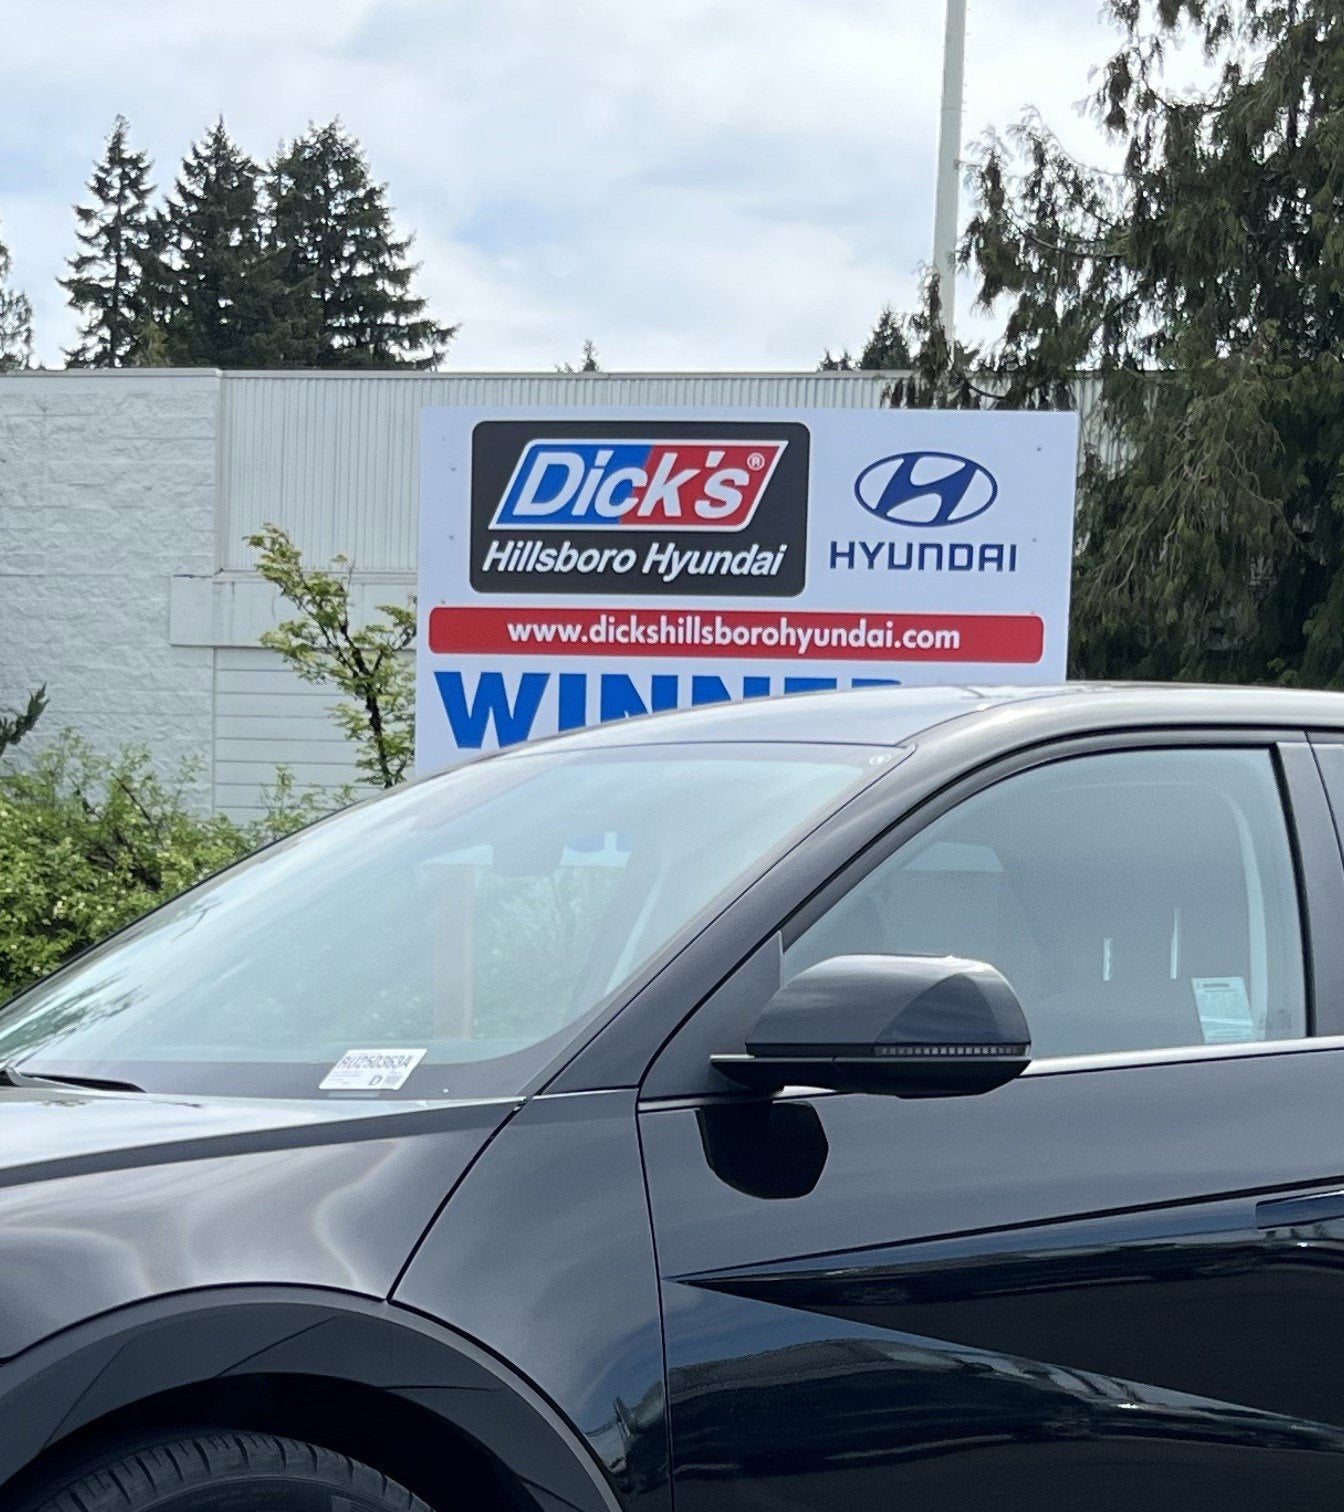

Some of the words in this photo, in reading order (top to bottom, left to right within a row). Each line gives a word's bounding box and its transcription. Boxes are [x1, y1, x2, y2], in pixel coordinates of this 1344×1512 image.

[481, 540, 638, 576] Hillsboro
[641, 543, 788, 583] Hyundai
[829, 541, 1017, 572] HYUNDAI
[507, 615, 960, 654] www.dickshillsborohyundai.com
[435, 671, 903, 749] WIN
